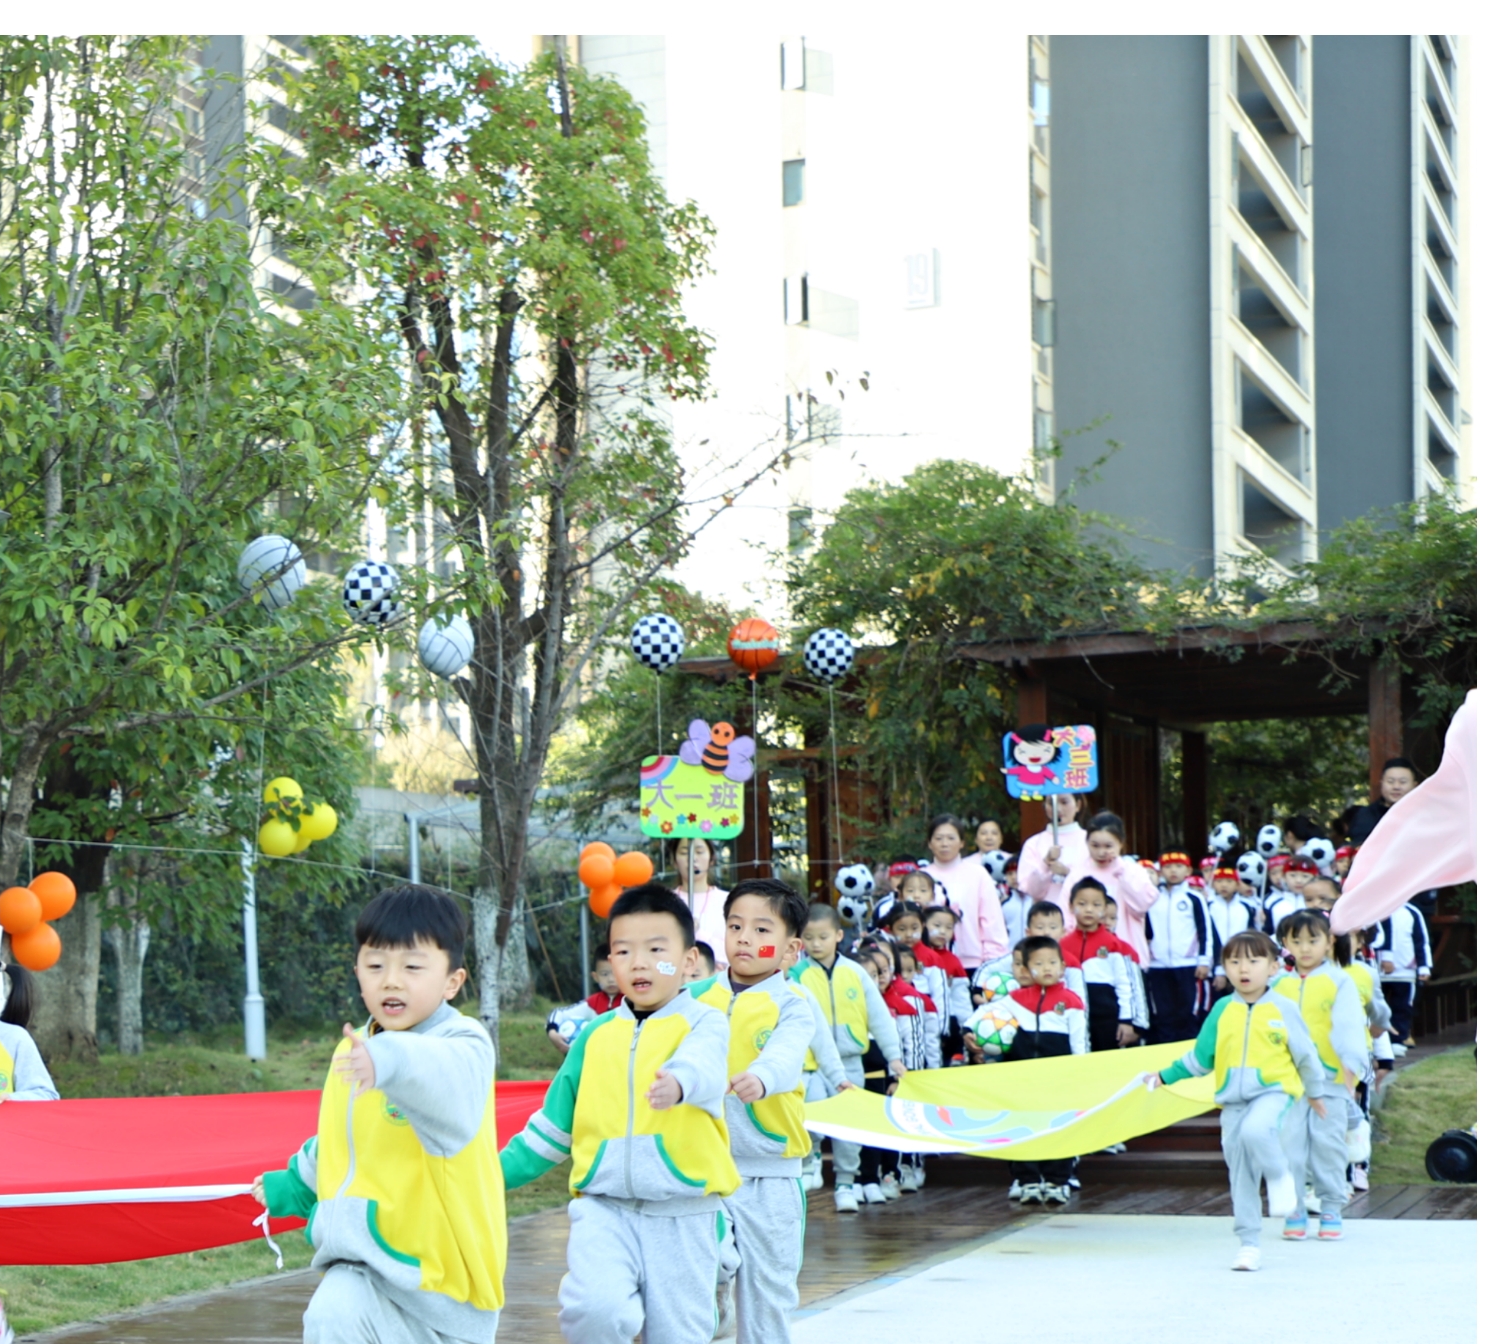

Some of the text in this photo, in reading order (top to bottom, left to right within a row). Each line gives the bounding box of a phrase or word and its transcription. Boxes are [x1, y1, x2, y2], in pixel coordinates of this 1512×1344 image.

[1052, 727, 1094, 788] 大三班
[644, 777, 739, 812] 大一班
